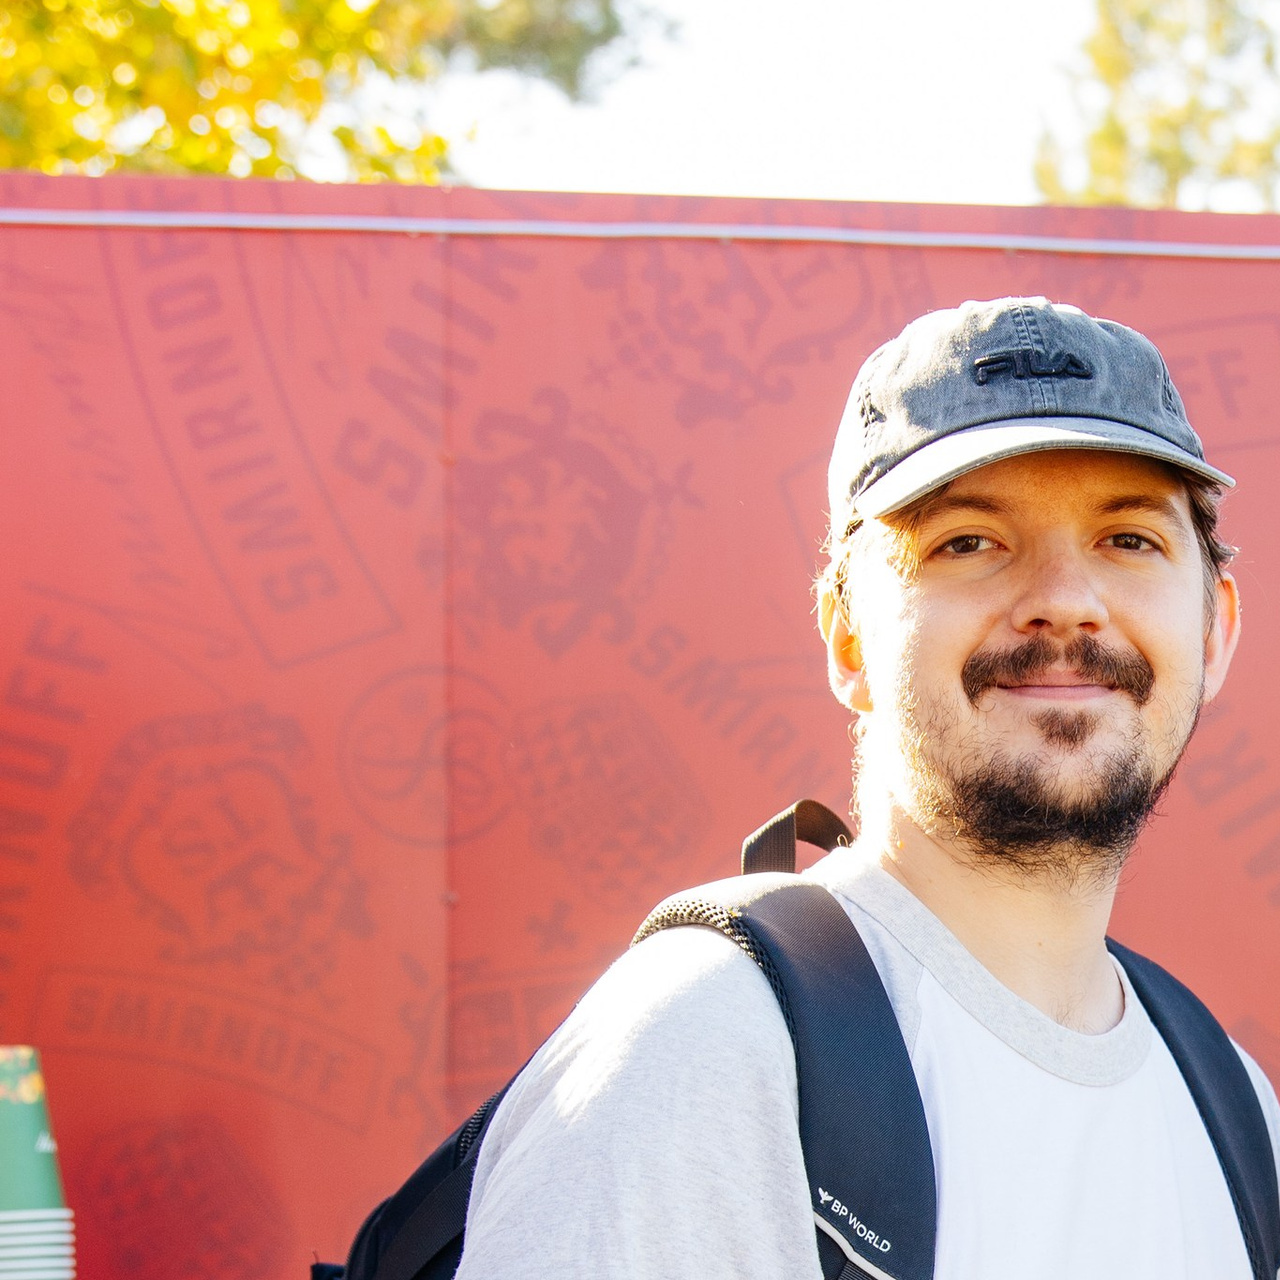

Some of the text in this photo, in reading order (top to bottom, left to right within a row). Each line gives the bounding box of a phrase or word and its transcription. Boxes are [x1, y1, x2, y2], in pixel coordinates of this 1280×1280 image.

[974, 350, 1093, 386] FILA
[64, 984, 351, 1095] SMIRNOFF
[831, 1199, 891, 1252] BP WORLD
